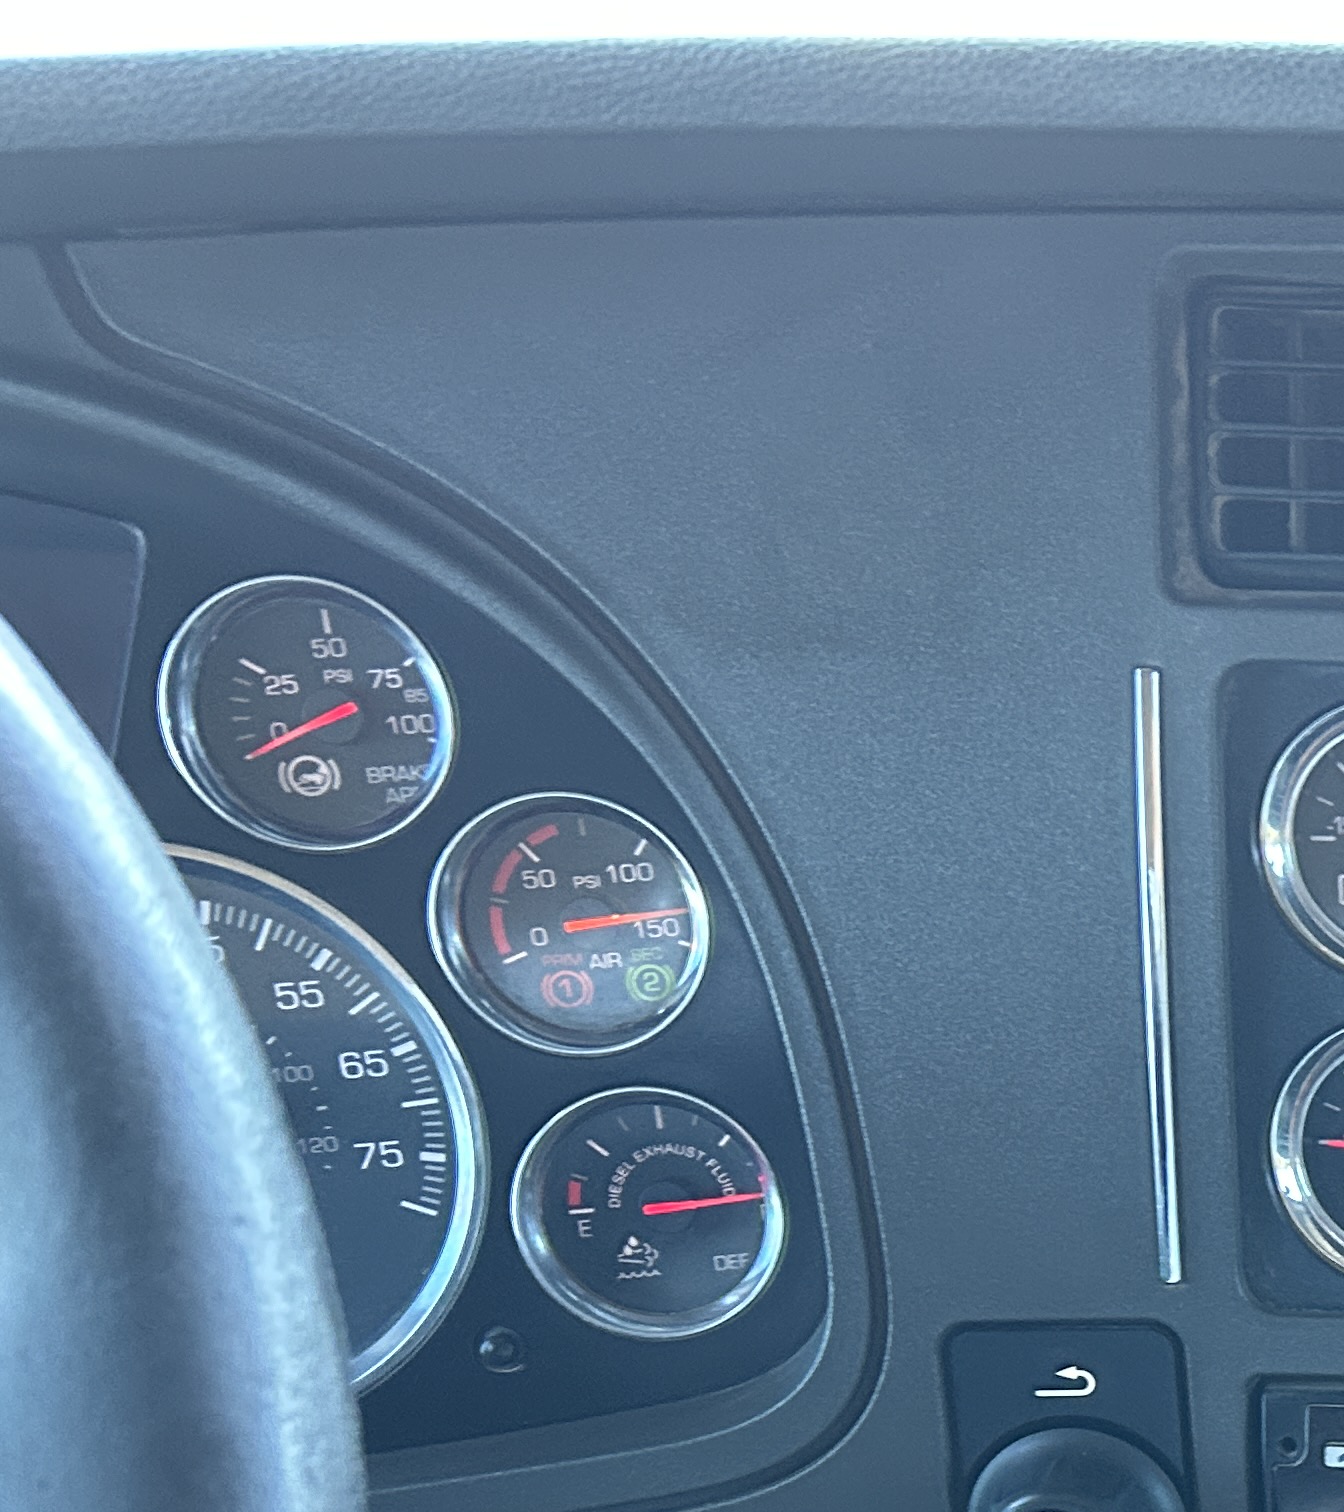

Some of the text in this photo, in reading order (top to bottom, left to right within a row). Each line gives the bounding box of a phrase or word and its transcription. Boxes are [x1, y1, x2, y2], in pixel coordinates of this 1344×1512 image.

[309, 637, 348, 659] 50
[262, 674, 300, 696] 25
[322, 668, 353, 684] PSI
[365, 668, 404, 690] 75
[403, 689, 429, 703] 85
[269, 721, 289, 739] 0
[385, 713, 436, 735] 100
[365, 763, 431, 785] BRAK
[521, 868, 557, 890] 50
[572, 875, 602, 889] PSI
[604, 862, 655, 884] 100
[529, 926, 550, 947] 0
[633, 917, 681, 938] 150
[589, 952, 623, 970] AIR
[272, 980, 326, 1011] 55
[337, 1050, 390, 1080] 65
[352, 1139, 405, 1170] 75
[607, 1141, 738, 1209] DIESEL EXHAUST FLUID
[576, 1219, 594, 1238] E
[712, 1252, 750, 1272] DEF
